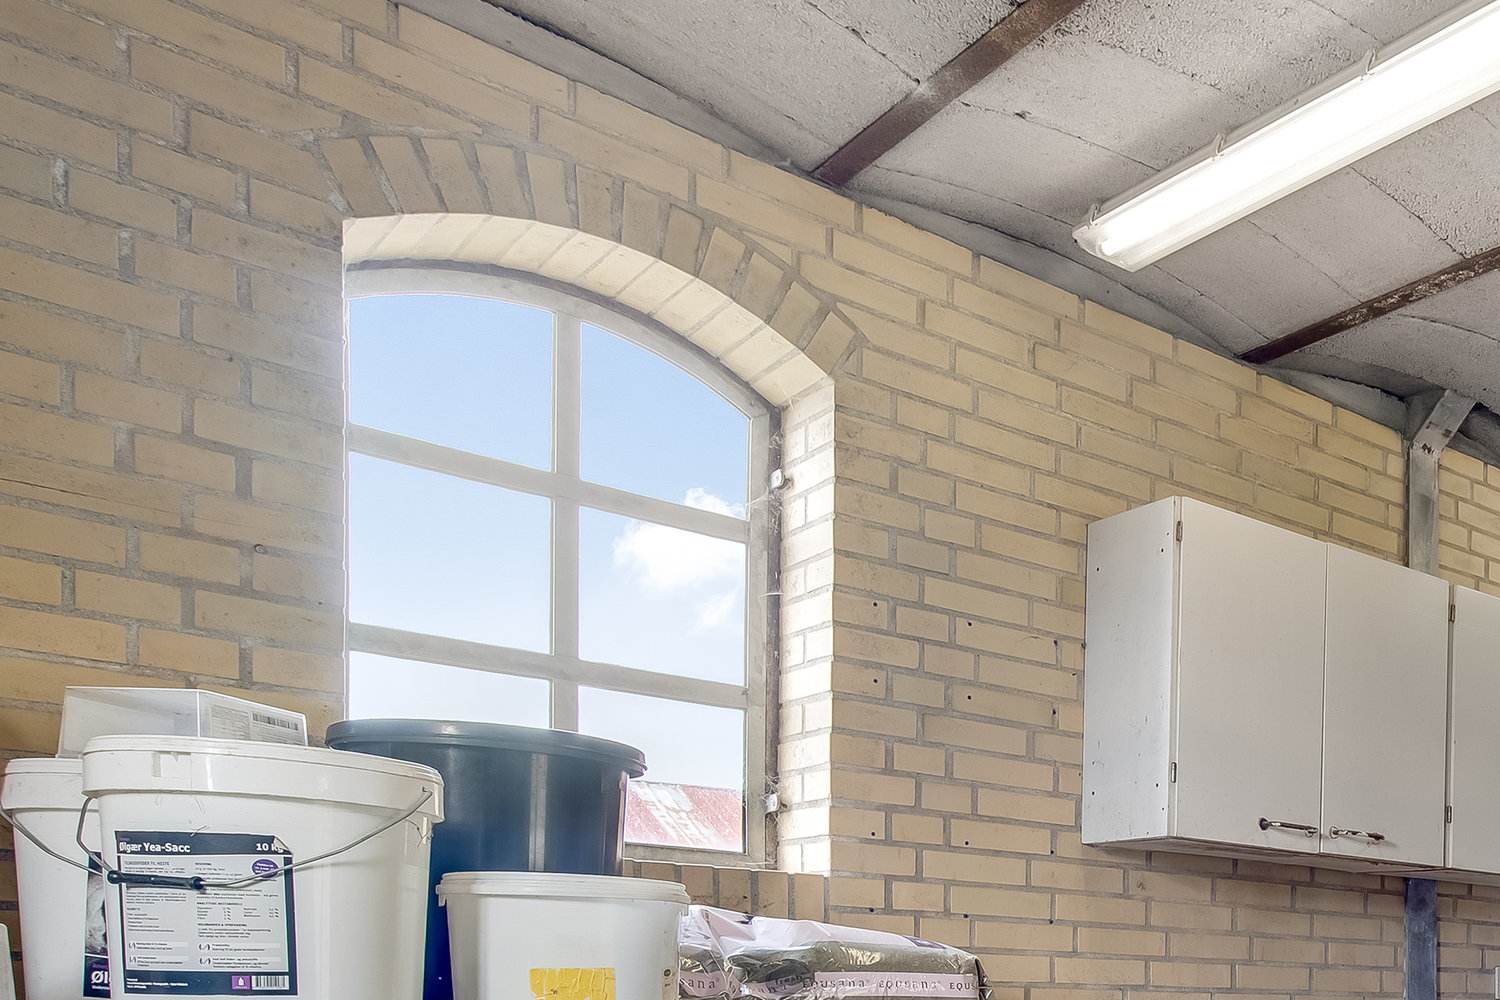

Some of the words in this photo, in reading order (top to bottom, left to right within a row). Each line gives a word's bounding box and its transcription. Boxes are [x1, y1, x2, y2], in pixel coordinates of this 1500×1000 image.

[119, 842, 142, 853] Ølgær
[143, 842, 191, 853] Yea-Sacc
[256, 843, 269, 851] 10
[680, 977, 716, 989] sana
